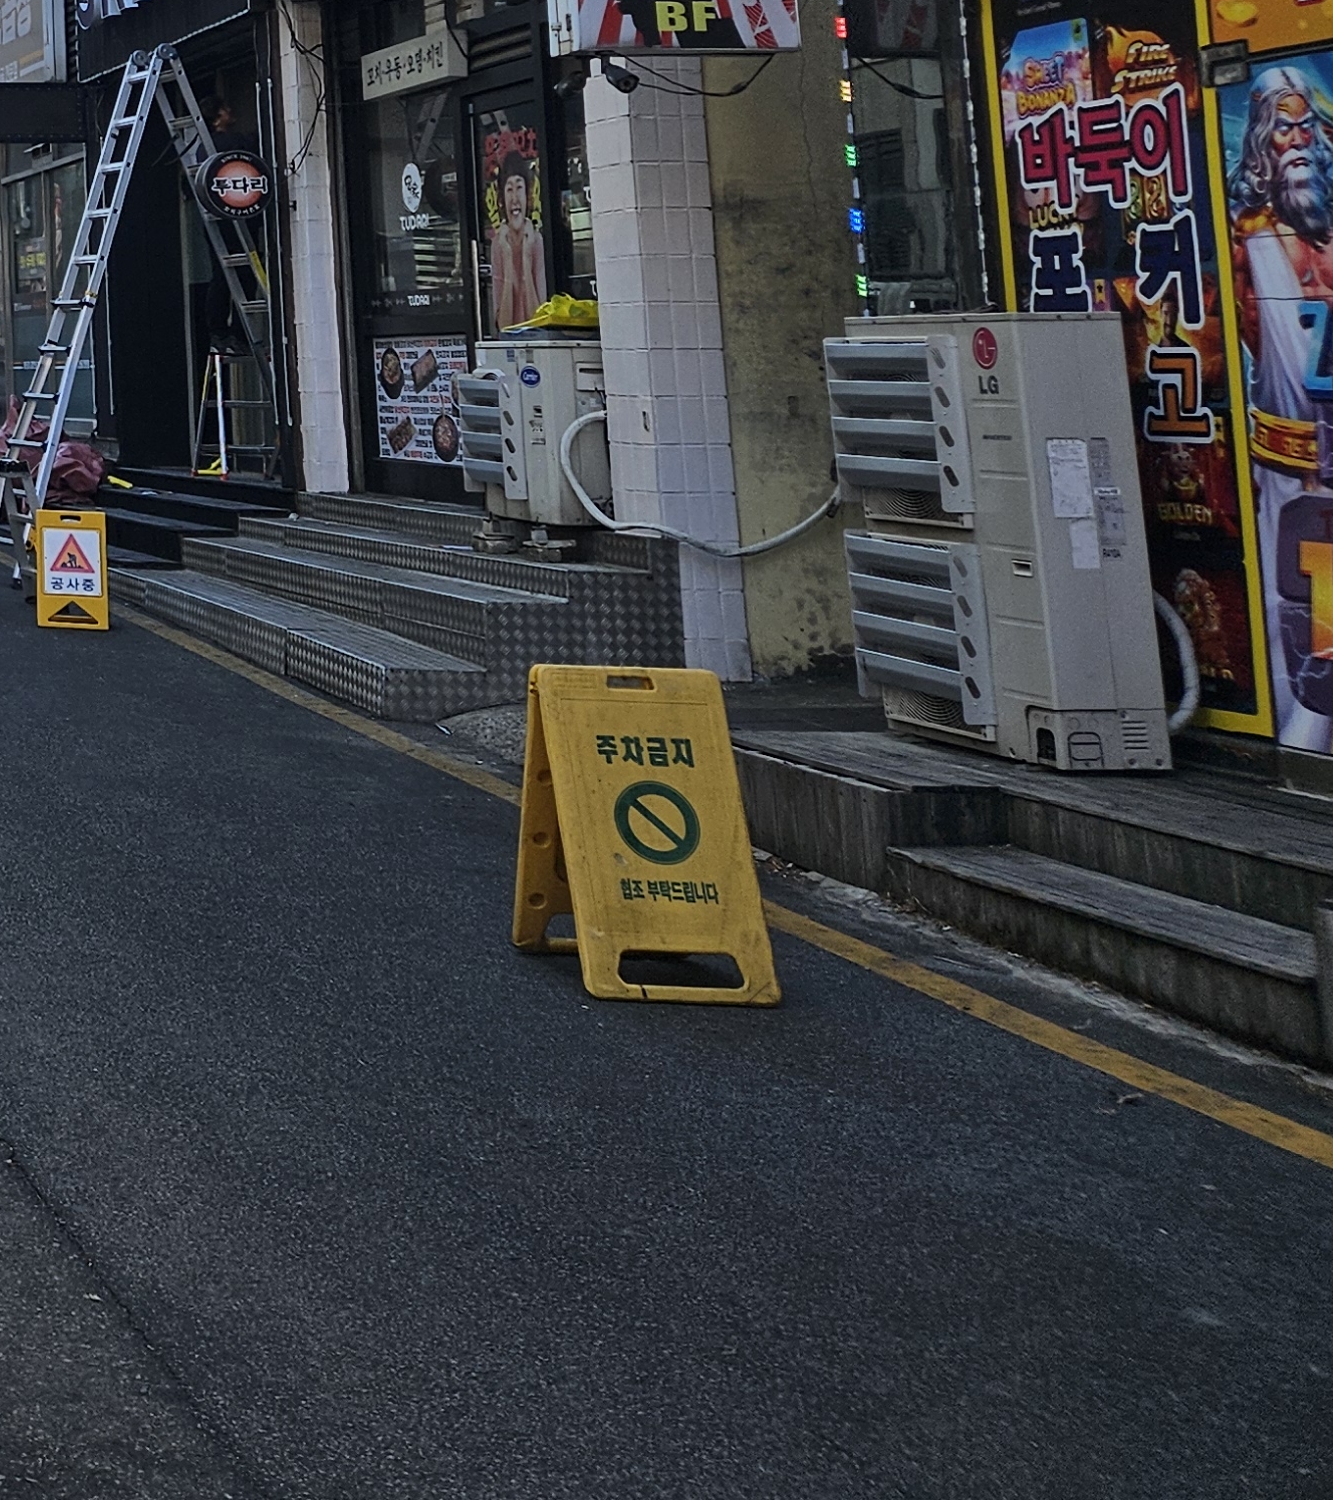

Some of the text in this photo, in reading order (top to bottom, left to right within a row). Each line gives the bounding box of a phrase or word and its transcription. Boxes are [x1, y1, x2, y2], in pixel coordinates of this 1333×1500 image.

[656, 0, 717, 33] BF
[1125, 41, 1171, 64] FIRE
[1111, 65, 1178, 93] STRIKE
[1019, 86, 1191, 211] 바둑이
[211, 175, 269, 197] 투다리
[399, 213, 430, 231] TUDARI
[978, 375, 999, 394] LG
[1158, 502, 1214, 525] GOLDEN
[50, 577, 96, 592] 공사중
[596, 735, 695, 767] 주차금지
[620, 878, 719, 905] 협조 부탁드립니다
